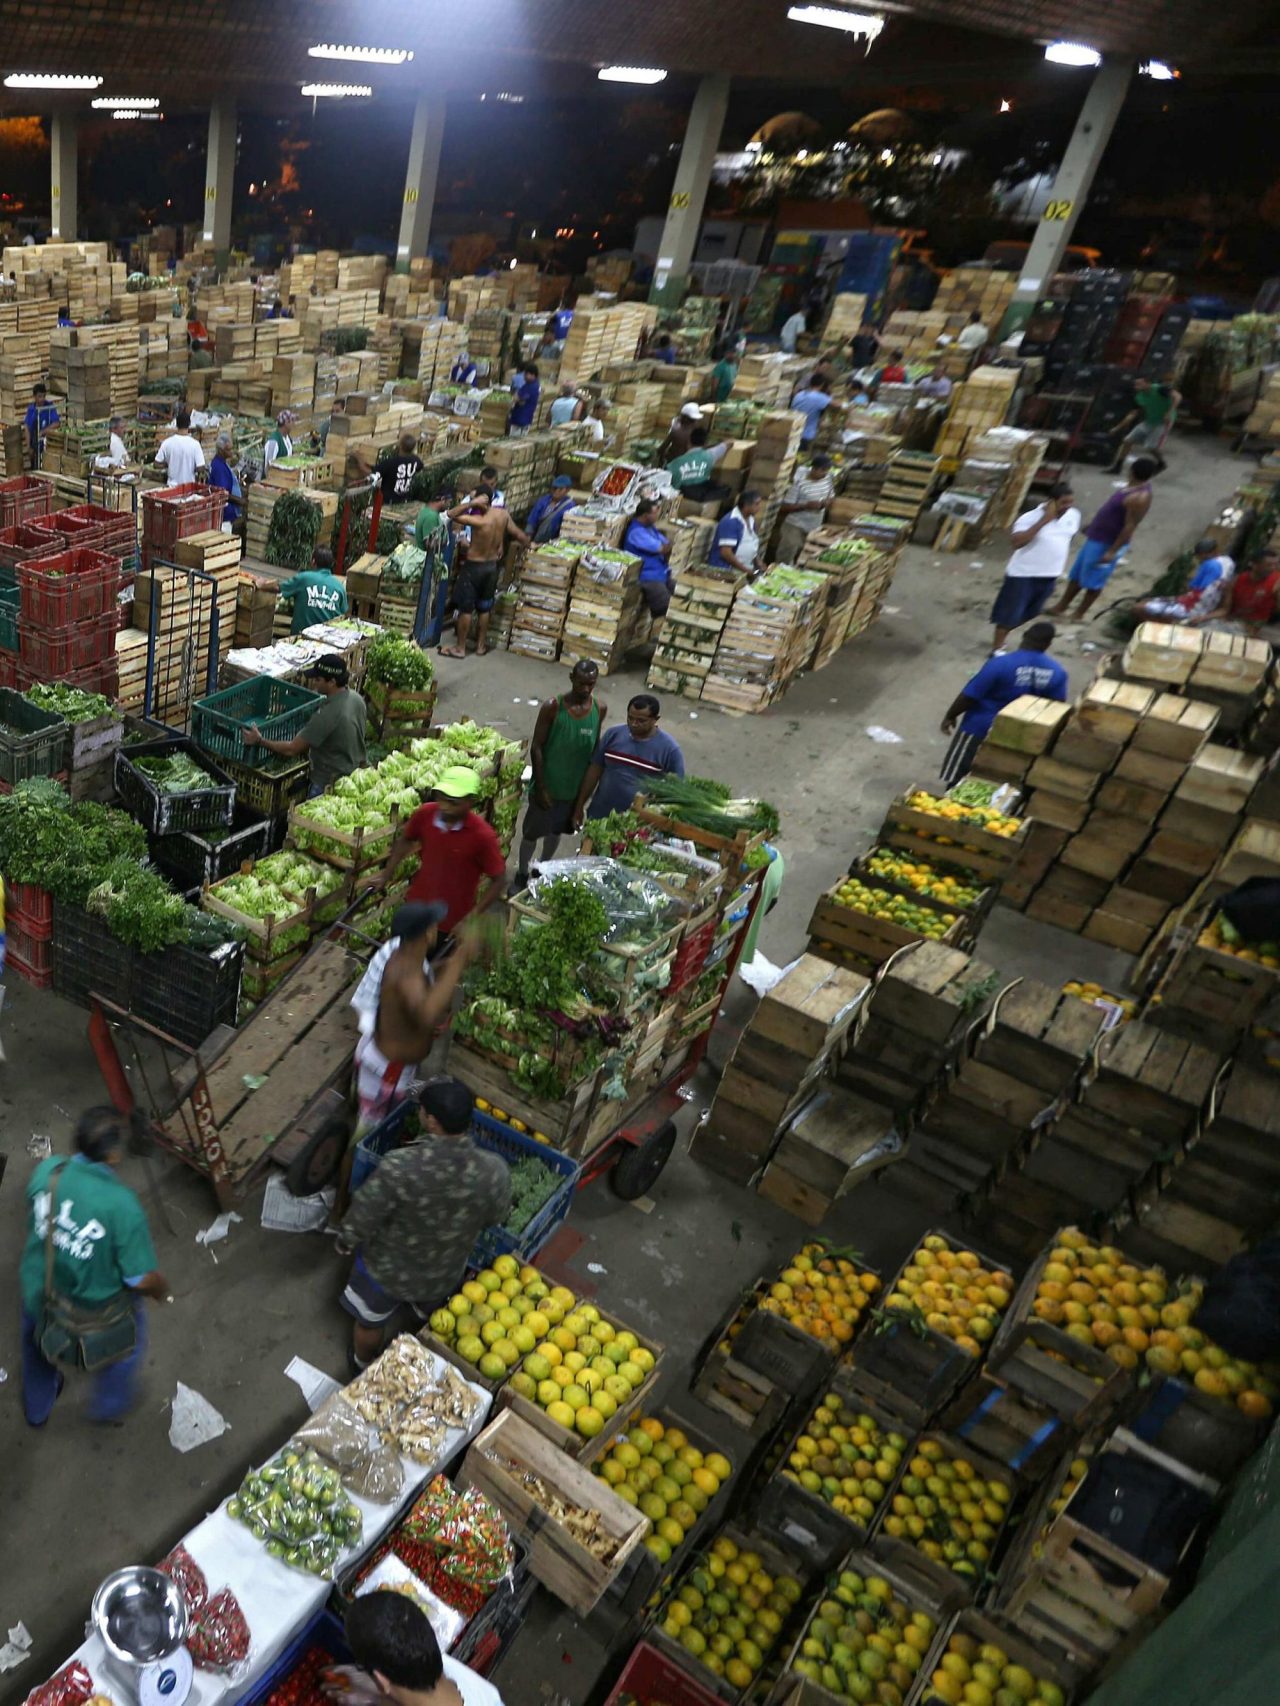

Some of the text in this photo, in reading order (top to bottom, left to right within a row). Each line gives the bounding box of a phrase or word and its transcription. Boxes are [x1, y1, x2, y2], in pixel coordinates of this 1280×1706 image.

[406, 188, 418, 203] 10
[671, 192, 689, 209] 06
[1044, 200, 1071, 220] 02
[397, 461, 417, 478] SU
